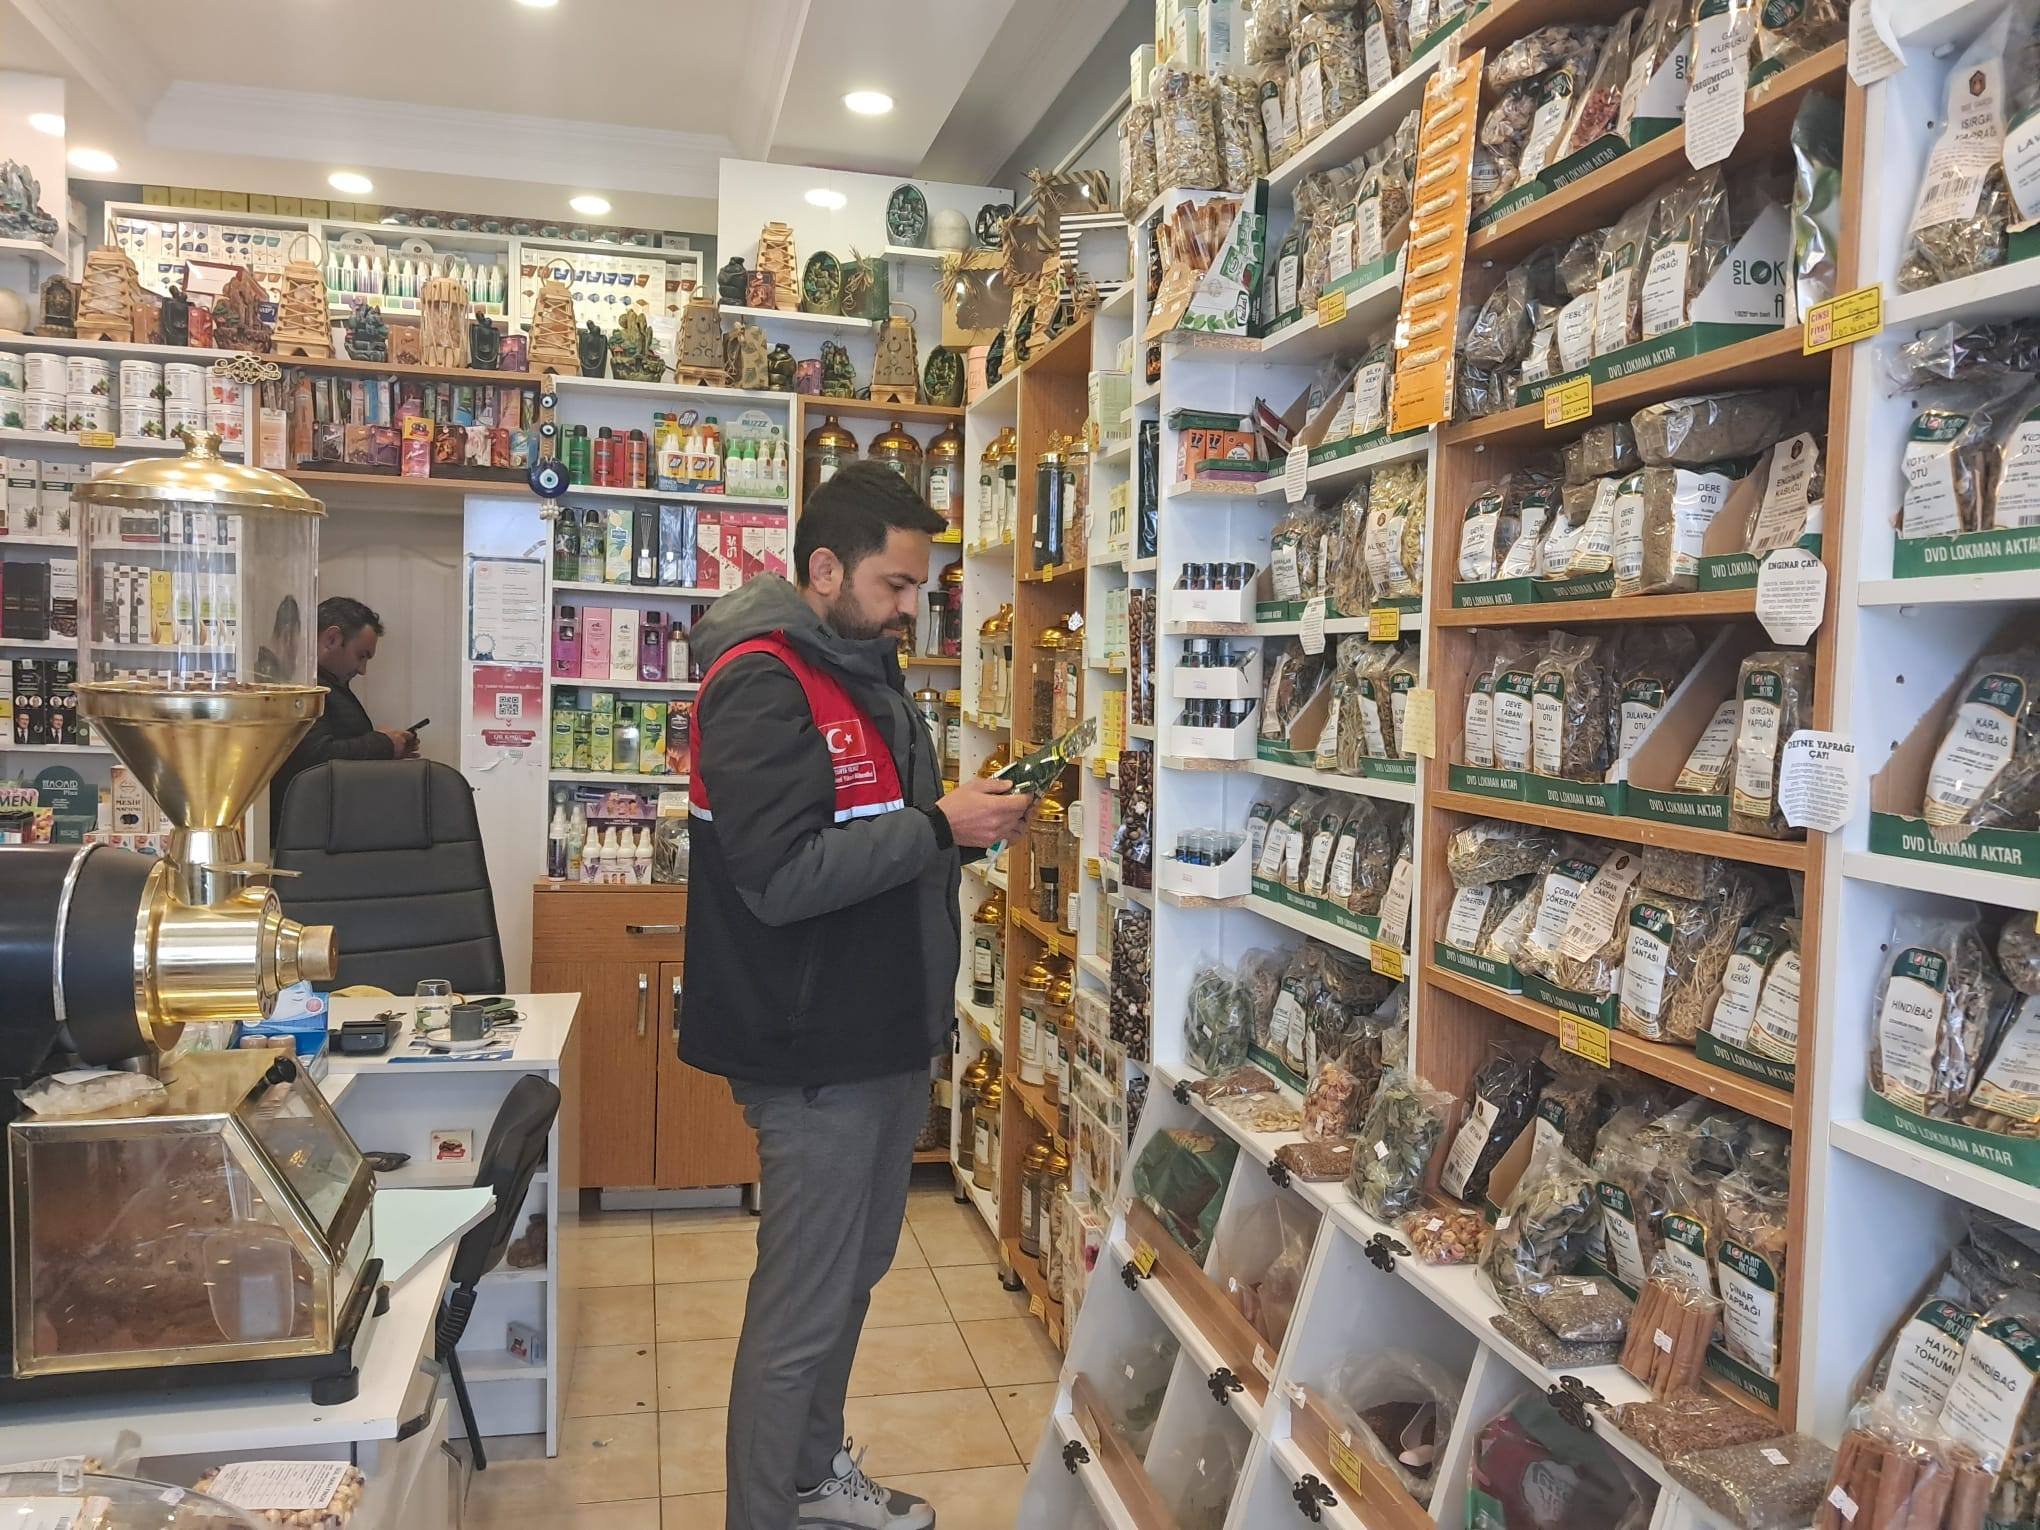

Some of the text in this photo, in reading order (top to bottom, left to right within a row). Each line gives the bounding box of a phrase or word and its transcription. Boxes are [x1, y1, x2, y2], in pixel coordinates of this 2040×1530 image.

[1732, 259, 1742, 285] DVD
[1608, 346, 1677, 379] DVD LOKMAN AKTAR
[1910, 467, 1929, 481] OTU
[1697, 483, 1721, 493] DERE
[1700, 494, 1717, 505] OTU
[1924, 546, 1948, 563] DVD
[1950, 541, 2001, 561] LOKMAN
[1711, 560, 1759, 578] DVD LOKMAN
[1505, 700, 1522, 710] DEVE
[1634, 722, 1646, 730] OTU
[1975, 717, 2000, 731] KARA
[1477, 776, 1500, 788] LOKMAN
[1500, 777, 1518, 791] AKTAR
[1560, 791, 1585, 805] LOKMAN
[1585, 794, 1606, 808] AKTAR
[1664, 799, 1695, 815] LOKMAN
[1696, 802, 1722, 818] AKTAR
[1902, 834, 1925, 851] DVD
[1980, 844, 2023, 866] AKTAR
[1634, 936, 1659, 950] ÇOBAN
[1631, 946, 1659, 962] ÇANTASI
[1478, 958, 1496, 975] AKTAR
[1894, 1114, 2014, 1167] DVD LOKMAN AKTAR
[1729, 1282, 1754, 1303] ÇINAR
[1925, 1336, 1960, 1361] HAYIT
